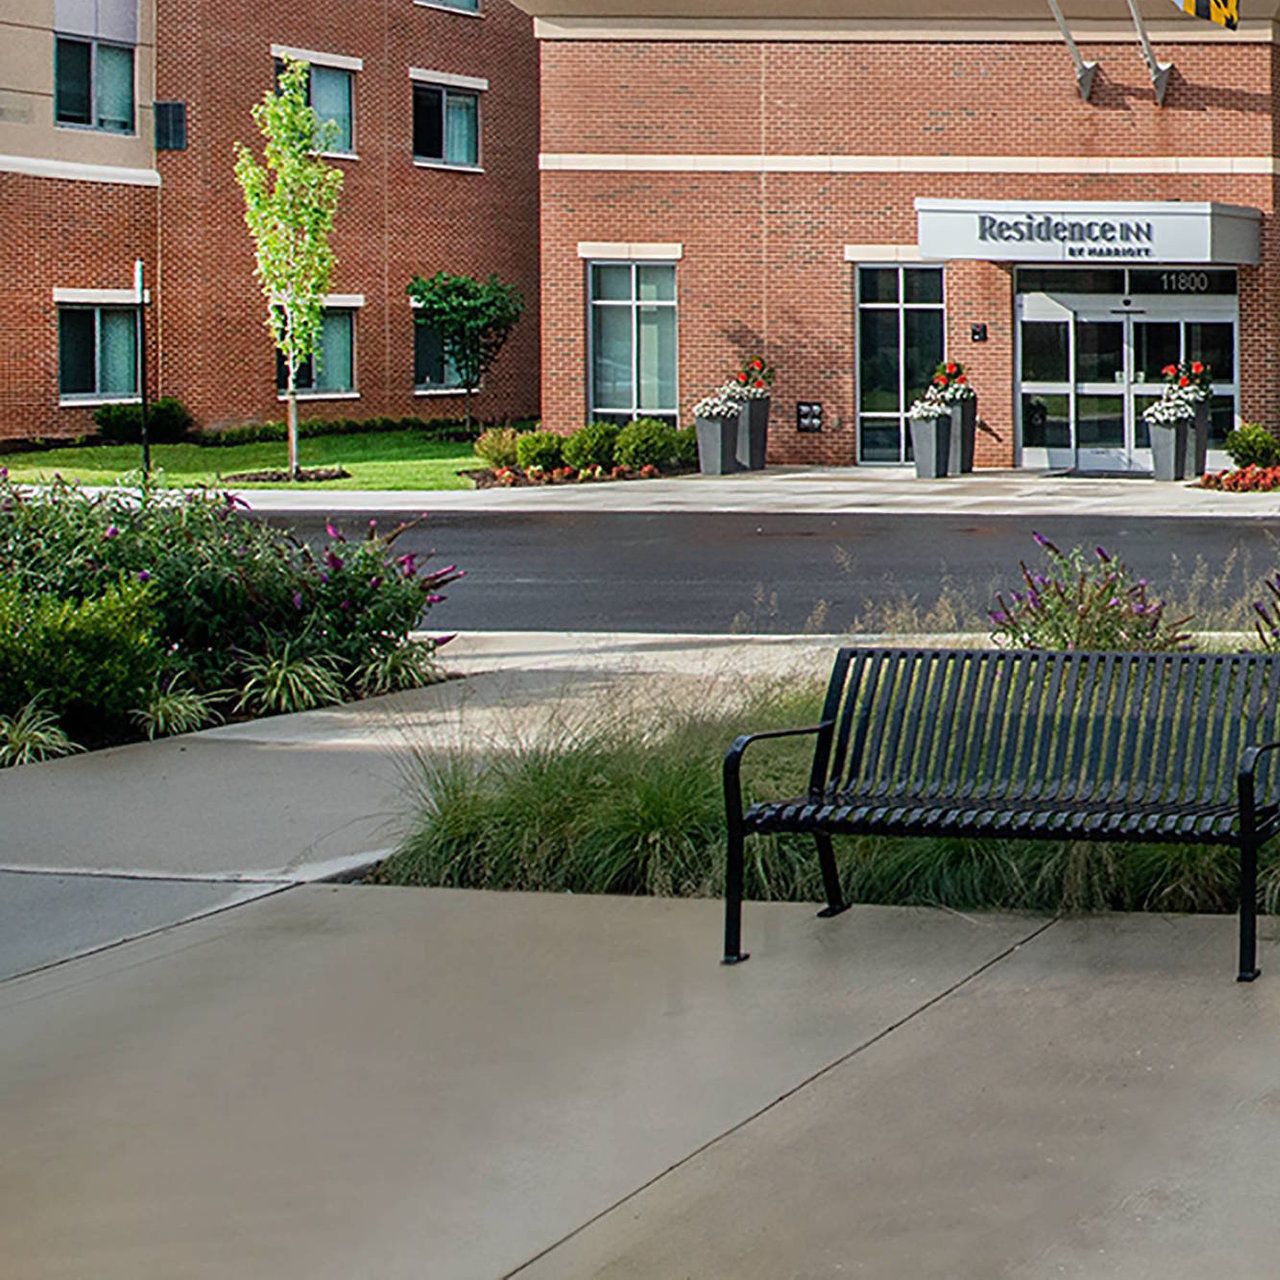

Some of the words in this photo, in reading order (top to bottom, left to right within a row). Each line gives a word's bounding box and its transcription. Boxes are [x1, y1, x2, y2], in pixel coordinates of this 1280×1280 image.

[978, 213, 1117, 243] Residence
[1119, 221, 1153, 242] INN
[1068, 246, 1085, 258] BY
[1161, 272, 1208, 291] 11800
